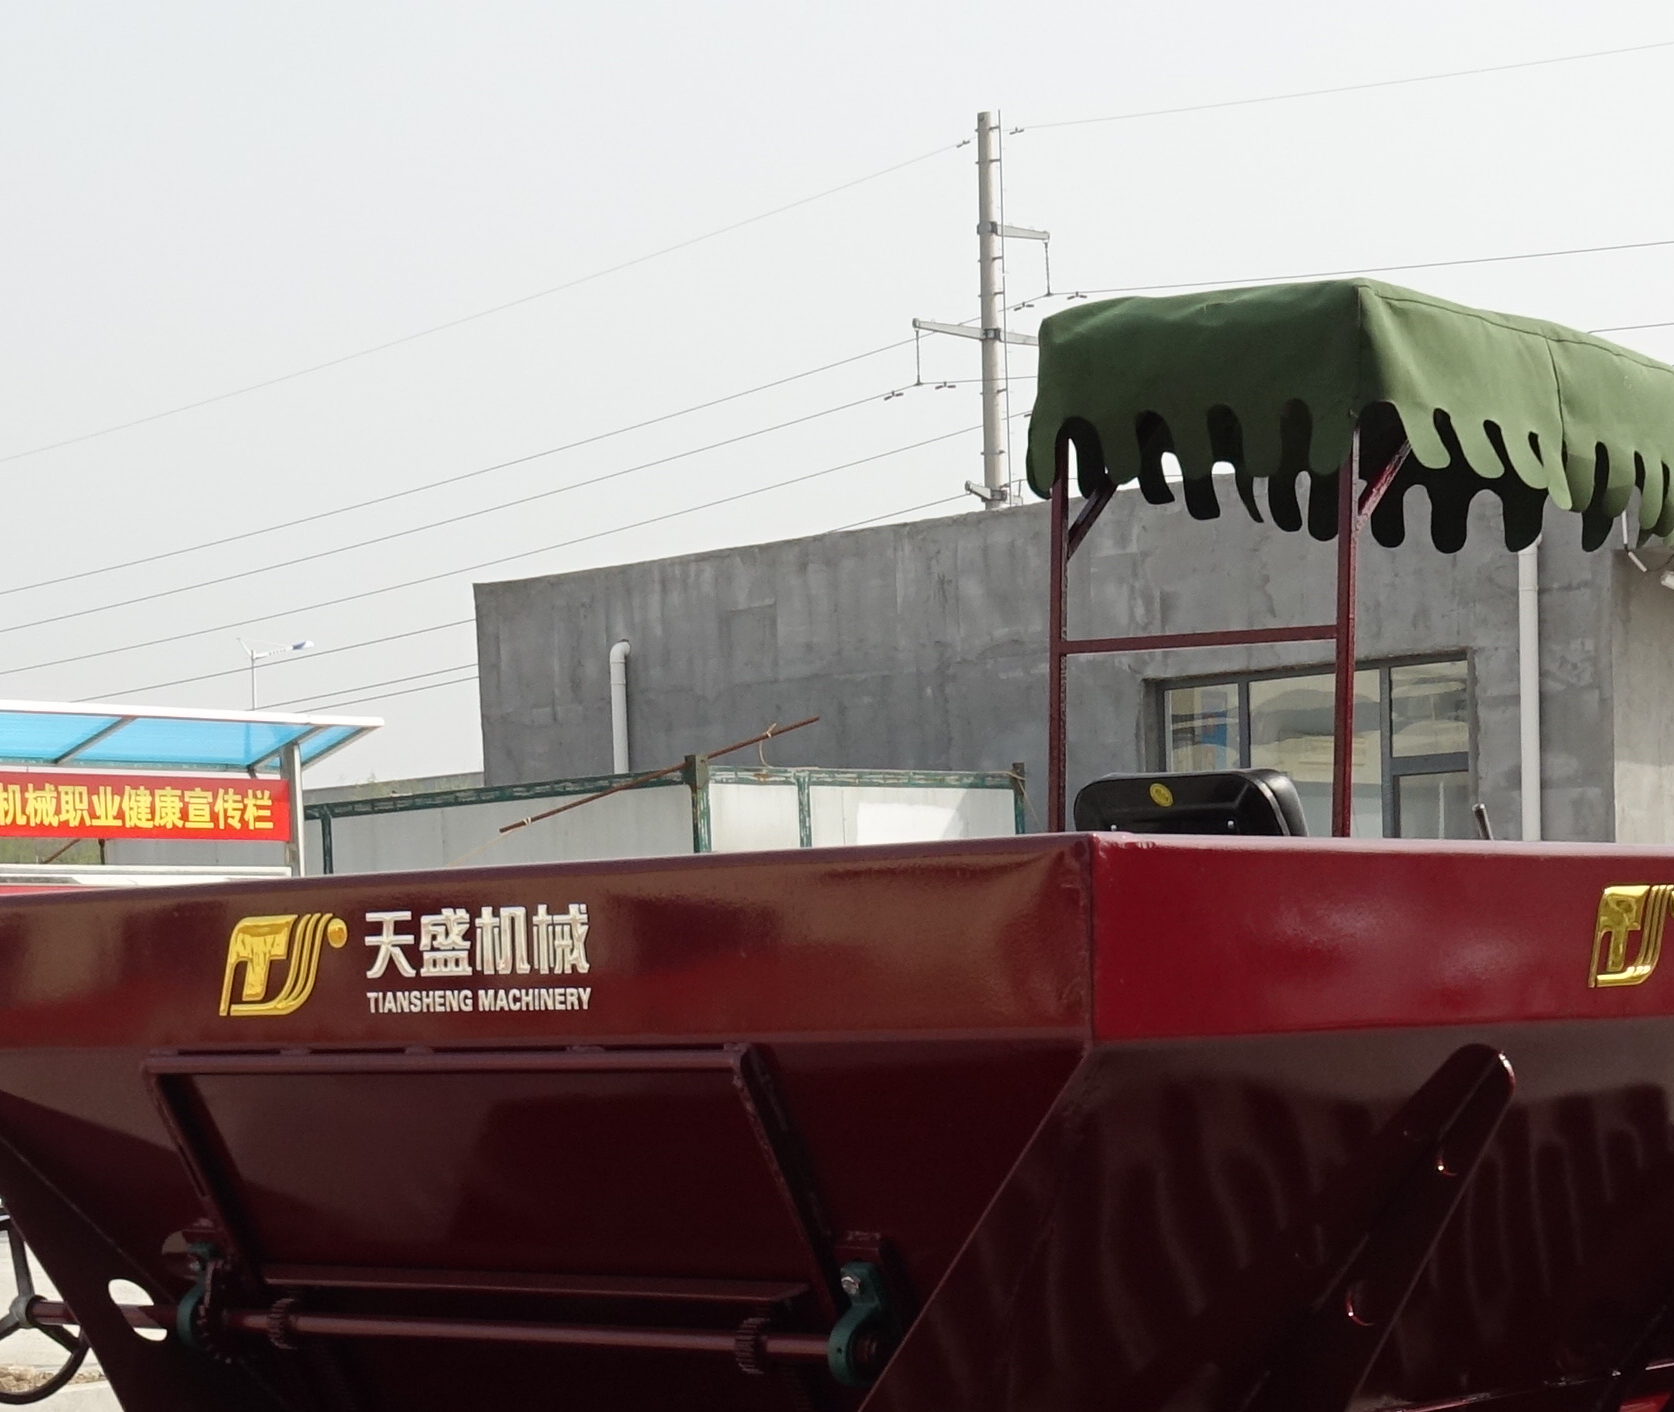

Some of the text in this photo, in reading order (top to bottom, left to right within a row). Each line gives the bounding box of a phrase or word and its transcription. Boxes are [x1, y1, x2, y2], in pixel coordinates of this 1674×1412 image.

[364, 903, 590, 979] 天盛机械
[366, 987, 592, 1014] TIANSHENG MACHINERY
